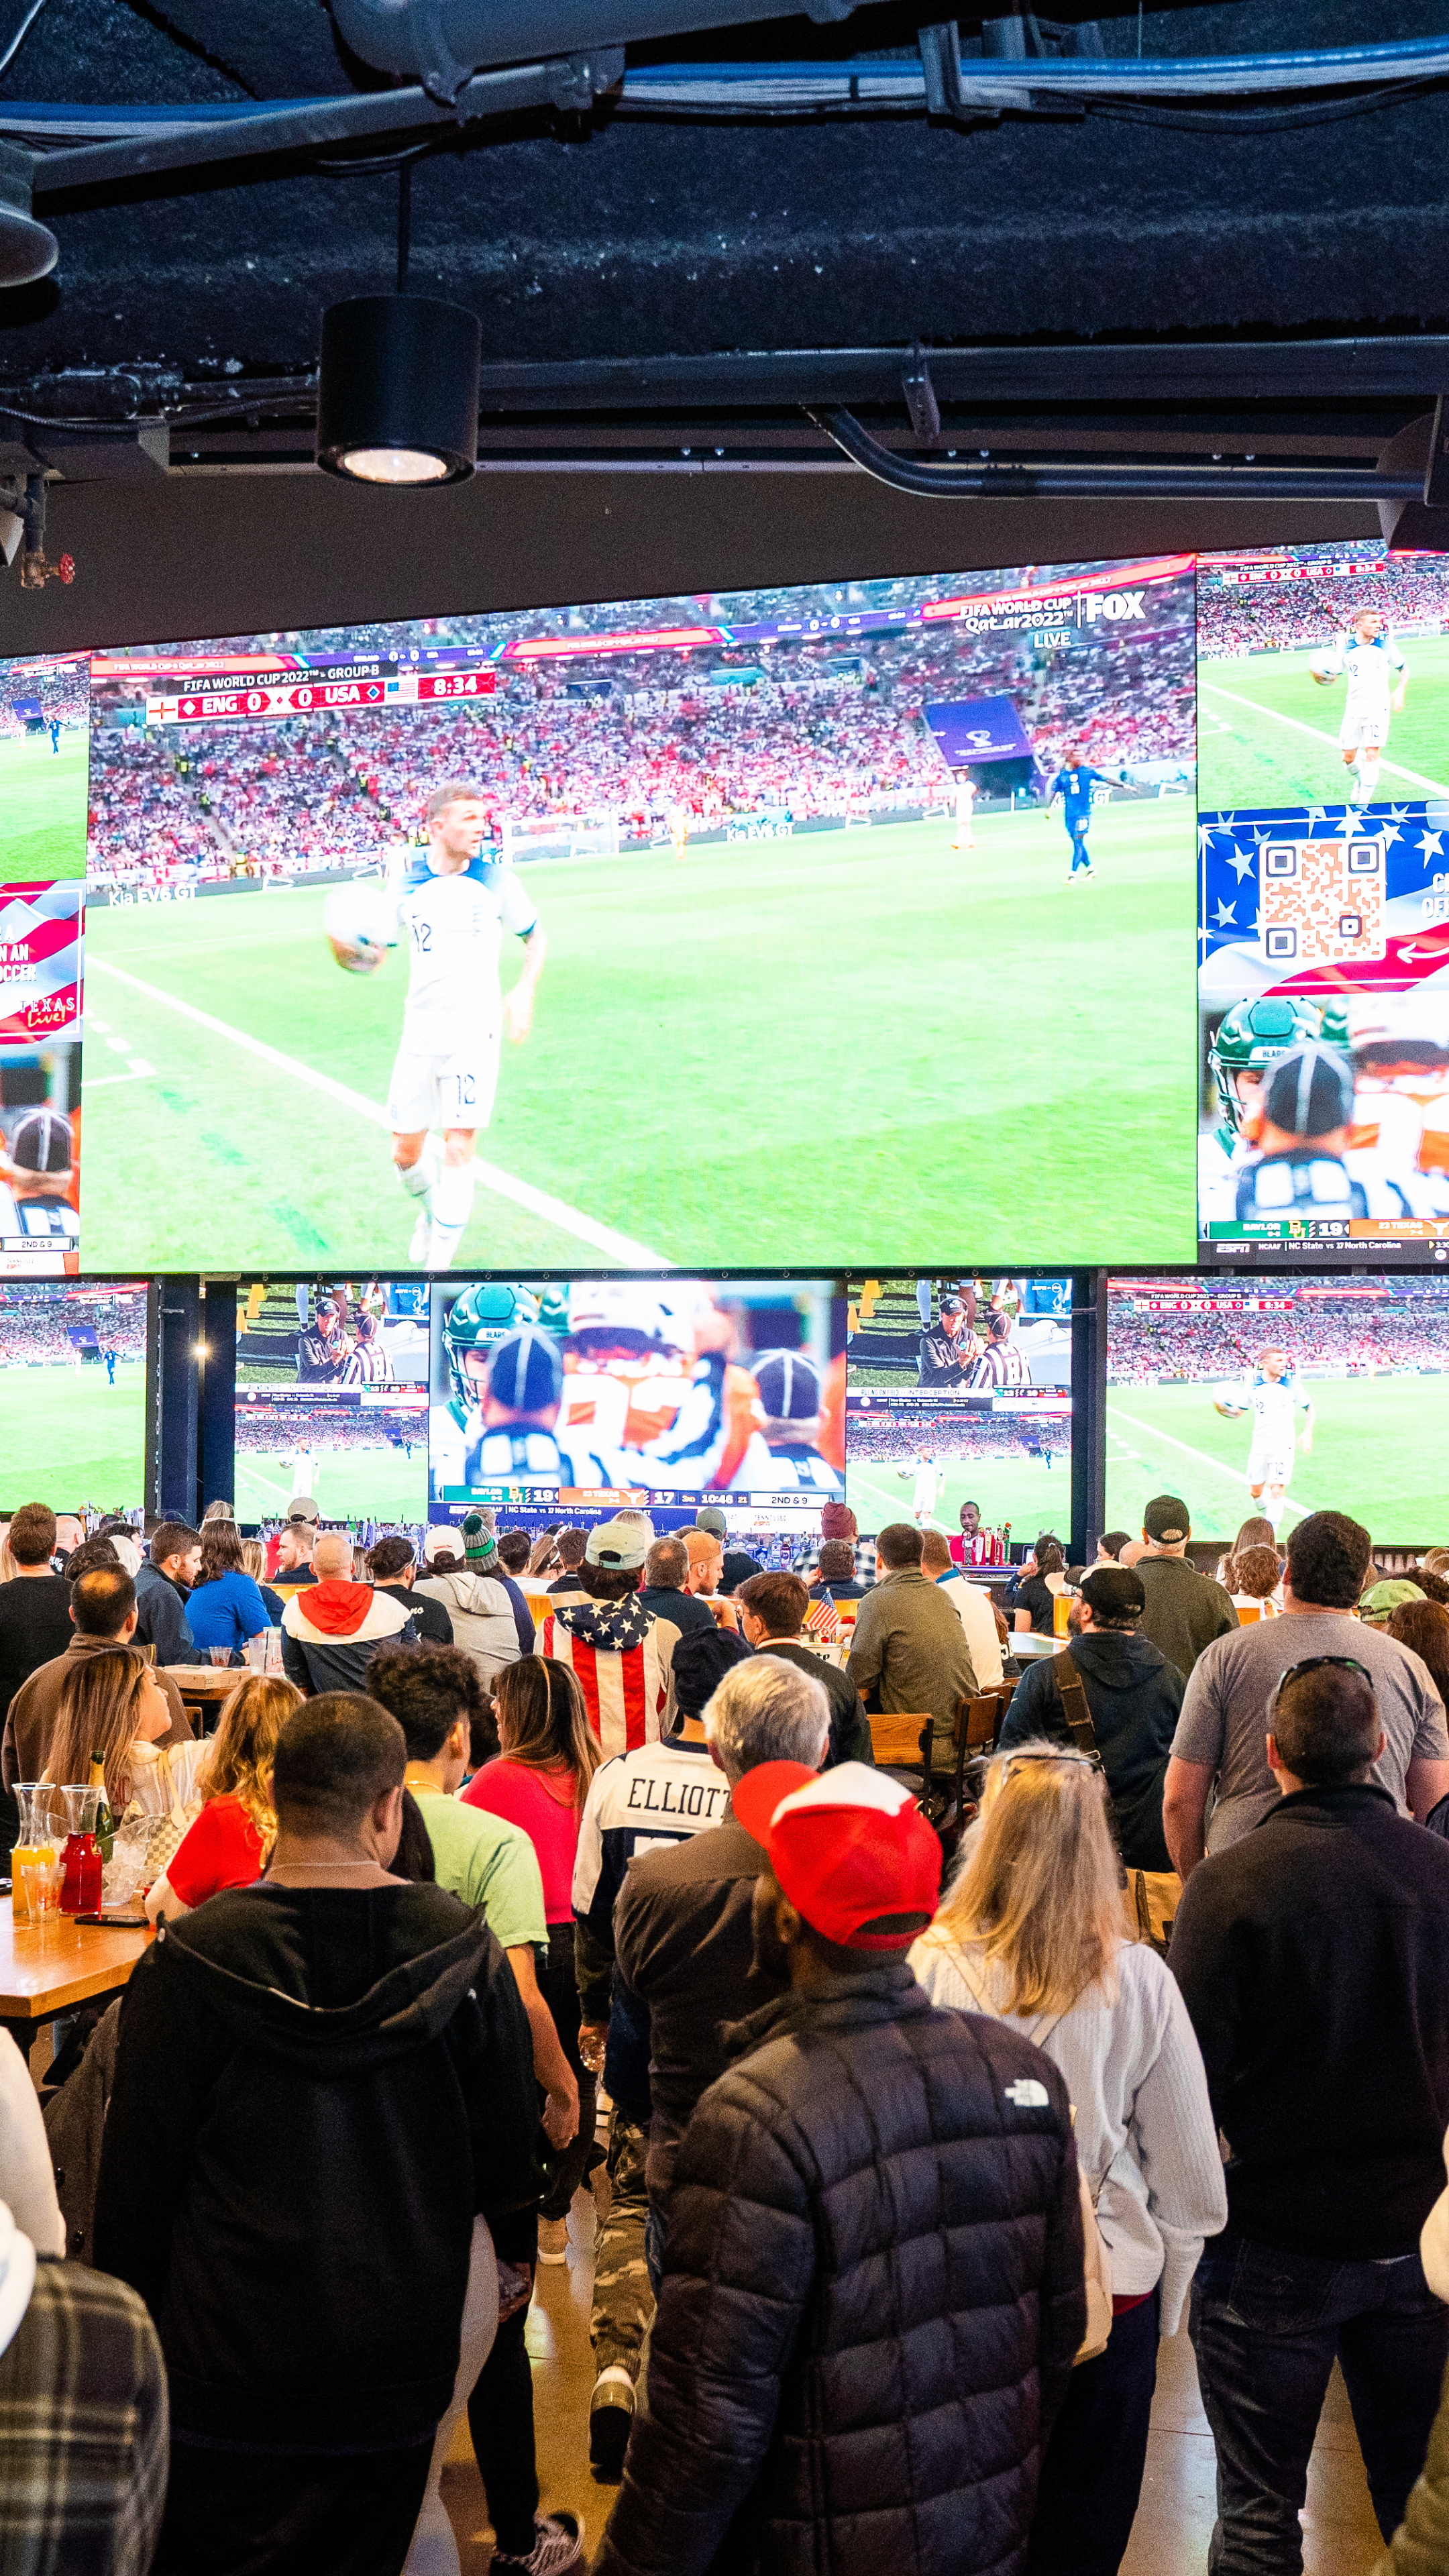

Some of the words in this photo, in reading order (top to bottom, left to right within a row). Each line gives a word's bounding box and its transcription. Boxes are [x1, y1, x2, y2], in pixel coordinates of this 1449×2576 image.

[1270, 572, 1277, 580] 0
[1294, 569, 1301, 577] 0
[1306, 568, 1324, 576] USA
[960, 604, 991, 618] FIFA
[991, 600, 1043, 616] WORLD
[1043, 597, 1072, 612] CUP
[1085, 591, 1146, 623] FOX
[1034, 632, 1071, 649] LIVE
[183, 679, 211, 692] FIFA
[212, 675, 256, 689] WORLD
[256, 674, 280, 686] CUP
[327, 665, 370, 680] GROUP
[370, 664, 380, 676] B
[433, 676, 478, 696] 8:34
[298, 688, 313, 707] 0
[325, 684, 361, 703] USA
[202, 695, 238, 714] ENG
[246, 693, 262, 711] 0
[1432, 873, 1449, 894] C
[109, 890, 134, 907] Kia
[137, 885, 172, 904] EV6
[174, 882, 198, 900] GT
[411, 922, 433, 953] 12
[10, 944, 29, 961] AN
[20, 997, 75, 1013] TEXAS
[28, 1006, 66, 1028] Live!
[455, 1073, 476, 1106] 12
[1242, 1222, 1281, 1231] BAYLOR
[1318, 1222, 1343, 1236] 19
[1378, 1222, 1390, 1230] 23
[1391, 1221, 1424, 1229] TEXAS
[1288, 1242, 1301, 1250] NC
[1301, 1242, 1324, 1250] State
[1344, 1241, 1368, 1249] North
[1368, 1241, 1402, 1249] Carolina
[1159, 1301, 1177, 1309] ENG
[1180, 1301, 1187, 1310] 0
[1204, 1301, 1212, 1310] 0
[471, 1487, 502, 1495] BAYLOR
[533, 1489, 554, 1503] 19
[592, 1490, 620, 1498] TEXAS
[653, 1491, 675, 1504] 17
[702, 1494, 734, 1504] 10:46
[519, 1506, 537, 1514] State
[574, 1507, 602, 1515] Carolina
